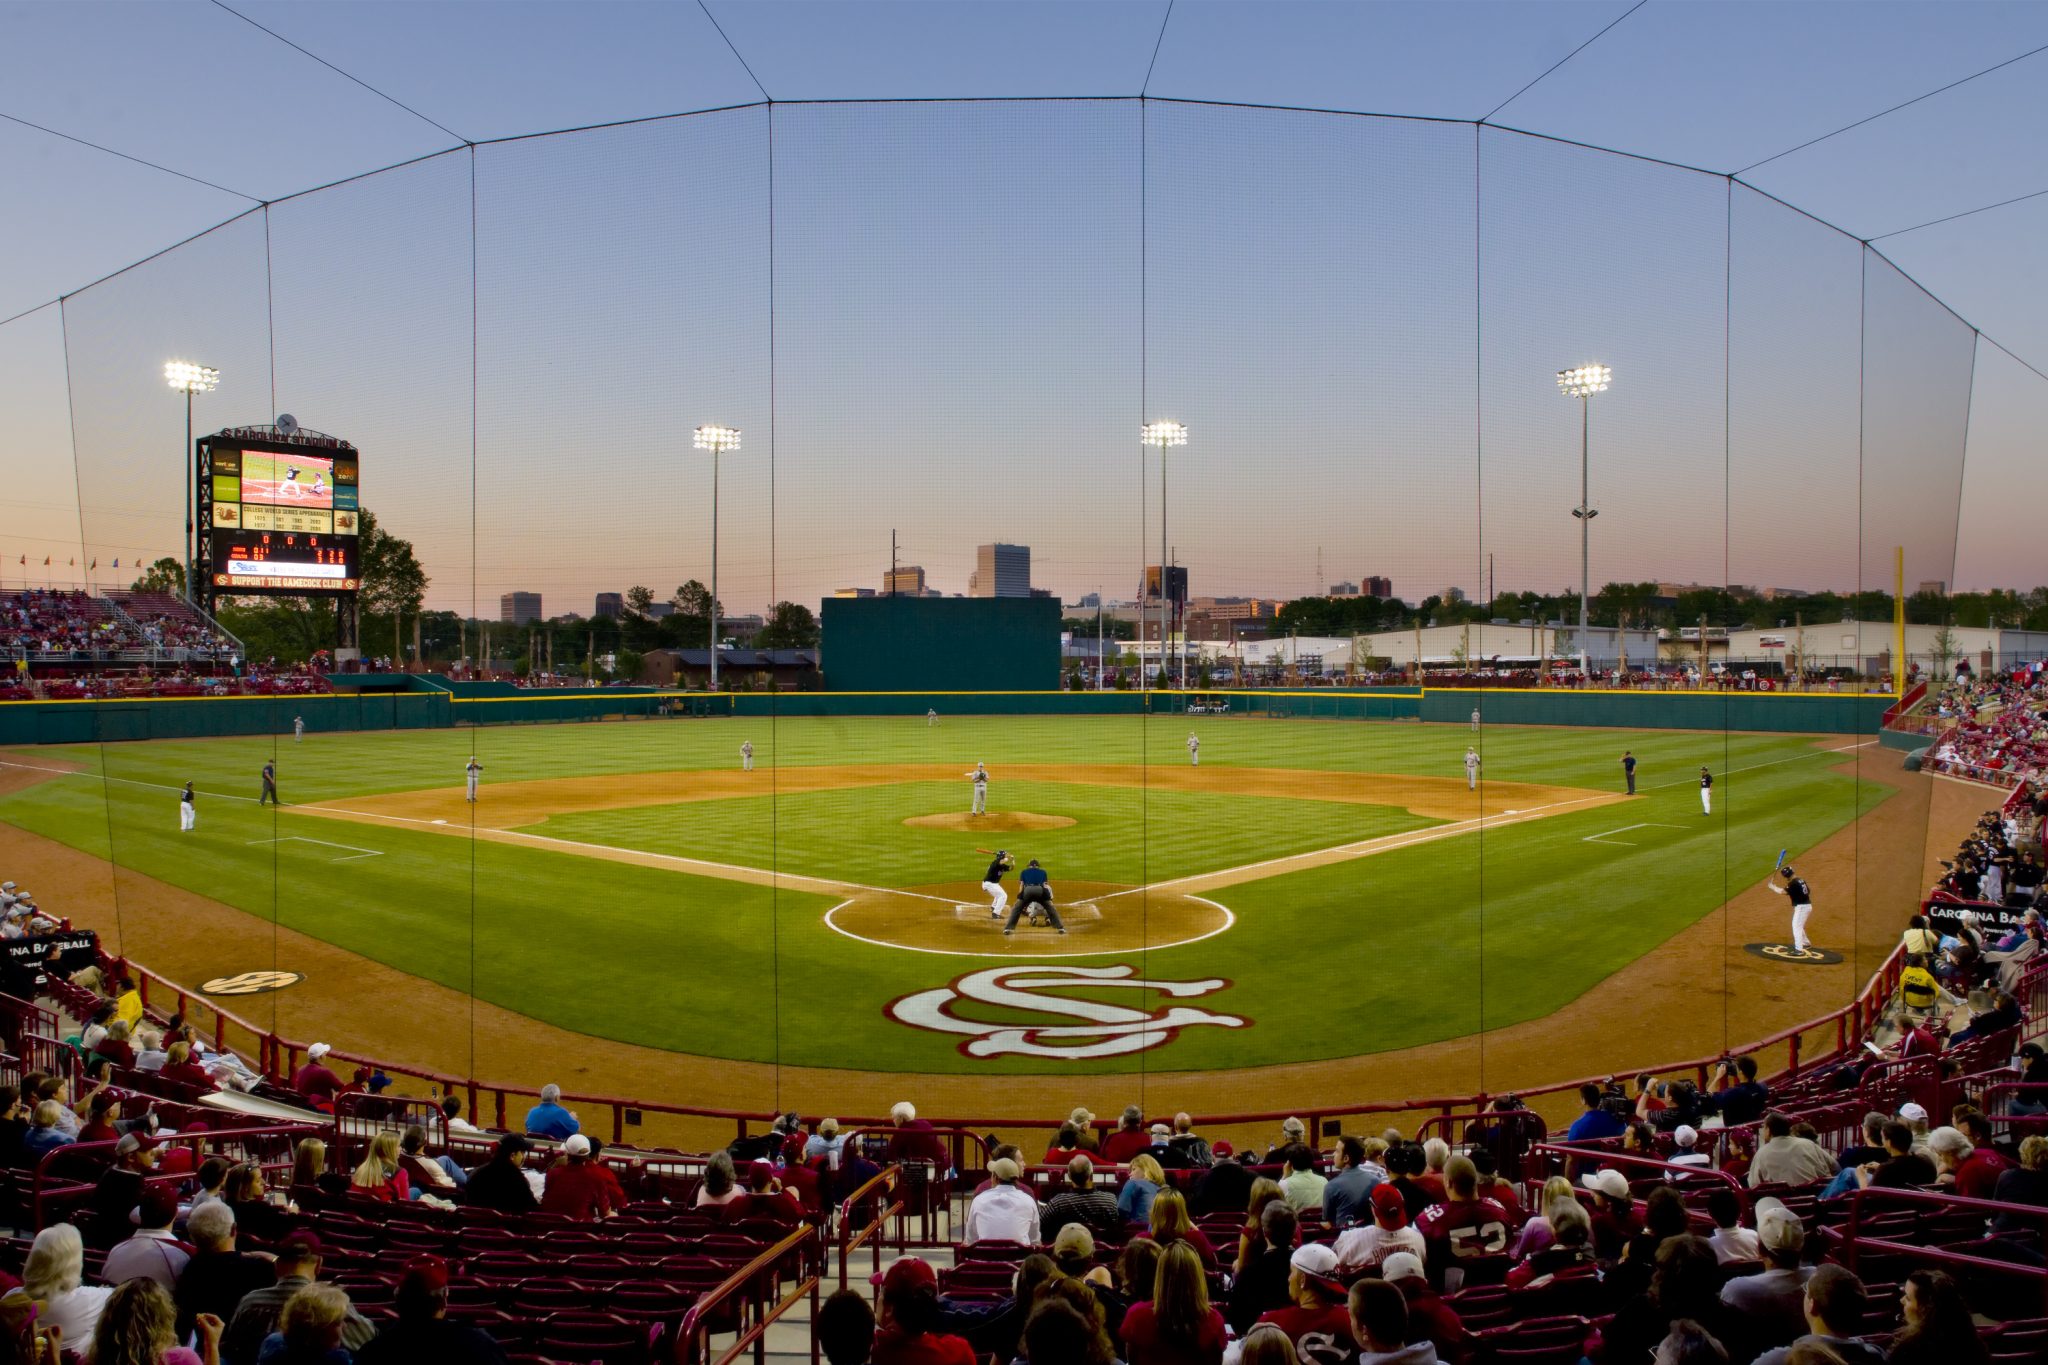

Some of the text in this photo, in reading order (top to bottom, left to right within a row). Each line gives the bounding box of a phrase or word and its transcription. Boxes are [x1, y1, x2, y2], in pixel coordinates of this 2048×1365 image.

[235, 428, 288, 443] CAROLINA
[292, 436, 338, 449] STADIUM
[232, 576, 265, 586] SUPPORT
[267, 577, 281, 586] THE
[282, 578, 321, 588] GAMECOCK
[1930, 906, 1995, 922] CAROINA
[33, 940, 91, 953] BAEBALL
[1424, 1204, 1444, 1222] 52
[1449, 1221, 1506, 1257] 52
